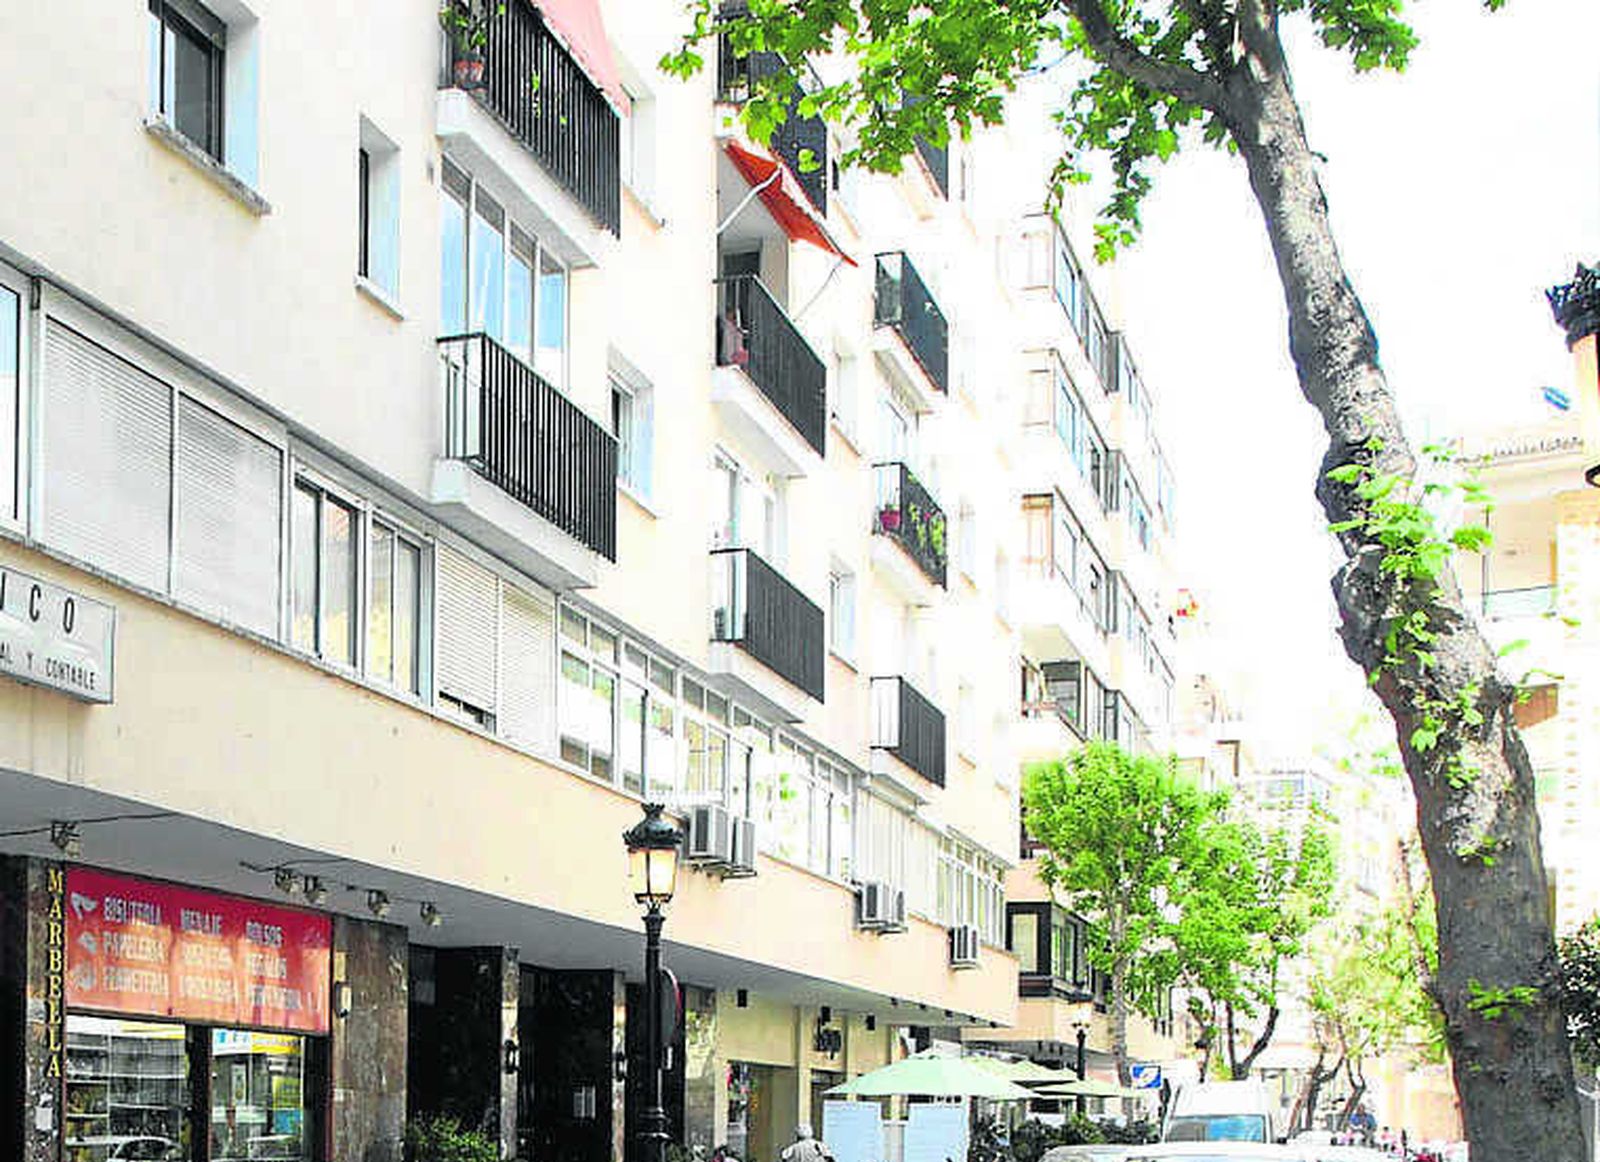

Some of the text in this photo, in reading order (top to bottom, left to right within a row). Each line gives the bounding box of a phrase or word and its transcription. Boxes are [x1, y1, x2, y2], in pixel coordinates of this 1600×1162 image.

[26, 653, 34, 671] Y
[45, 658, 96, 690] CONTABLE
[180, 908, 223, 936] MENAJE
